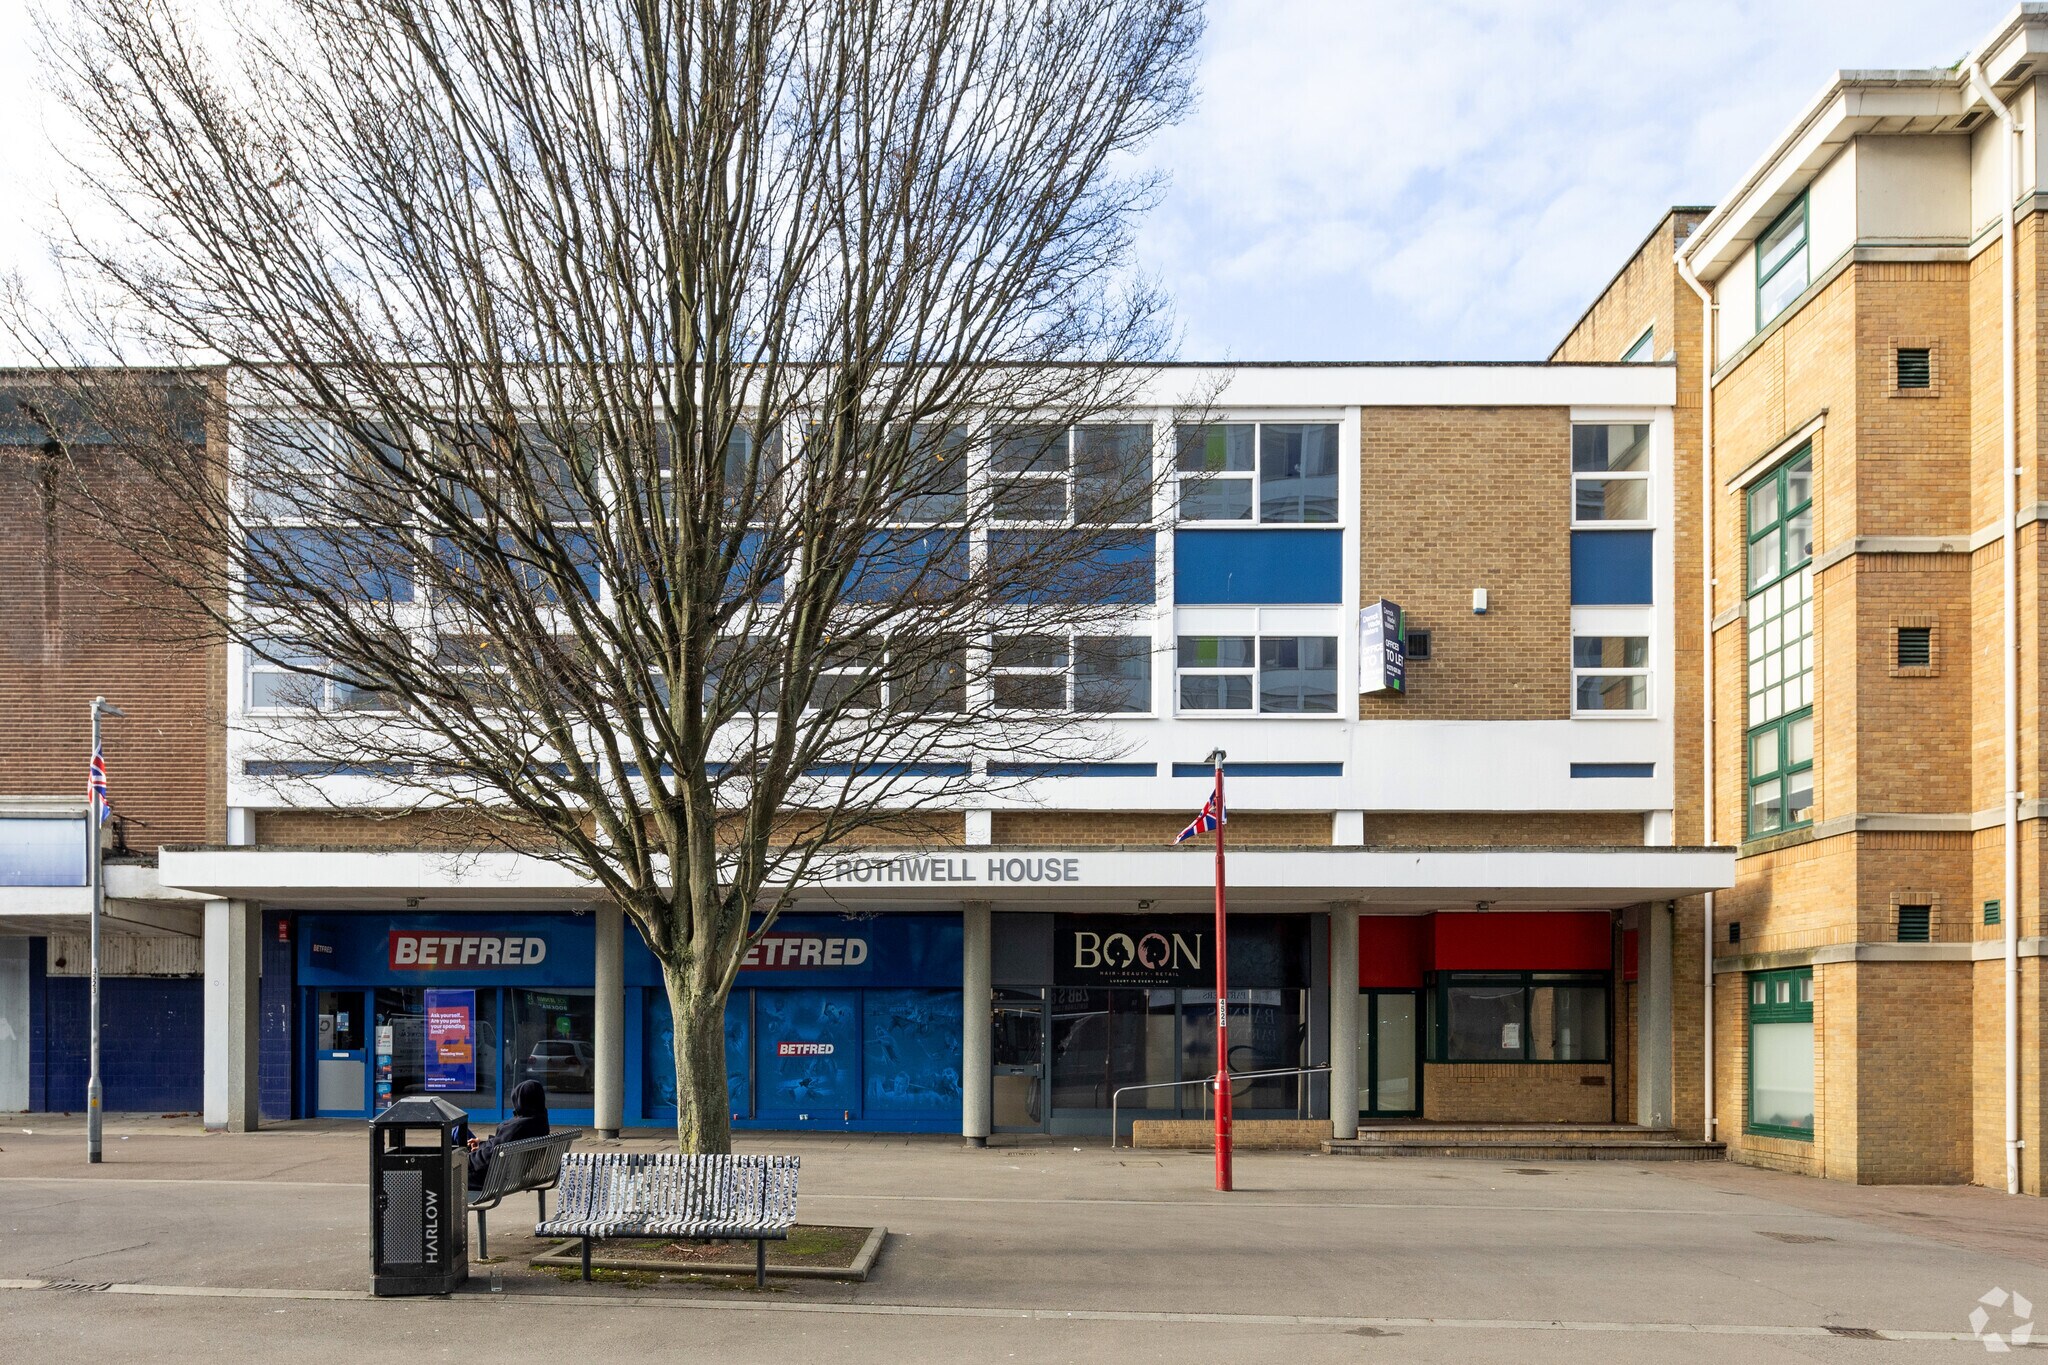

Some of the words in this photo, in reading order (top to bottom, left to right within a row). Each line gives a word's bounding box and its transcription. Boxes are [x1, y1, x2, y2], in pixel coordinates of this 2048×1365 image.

[1385, 639, 1400, 651] OFFICES
[1386, 649, 1395, 662] TO
[1395, 653, 1404, 667] LET
[836, 858, 976, 883] ROTHWELL
[988, 858, 1079, 882] HOUSE
[313, 944, 333, 954] BETFRED
[395, 937, 547, 965] BETFRED
[739, 938, 868, 966] ETFRED
[1074, 931, 1203, 969] BOON
[780, 1044, 834, 1054] BETFRED
[425, 1189, 438, 1263] HARLOW
